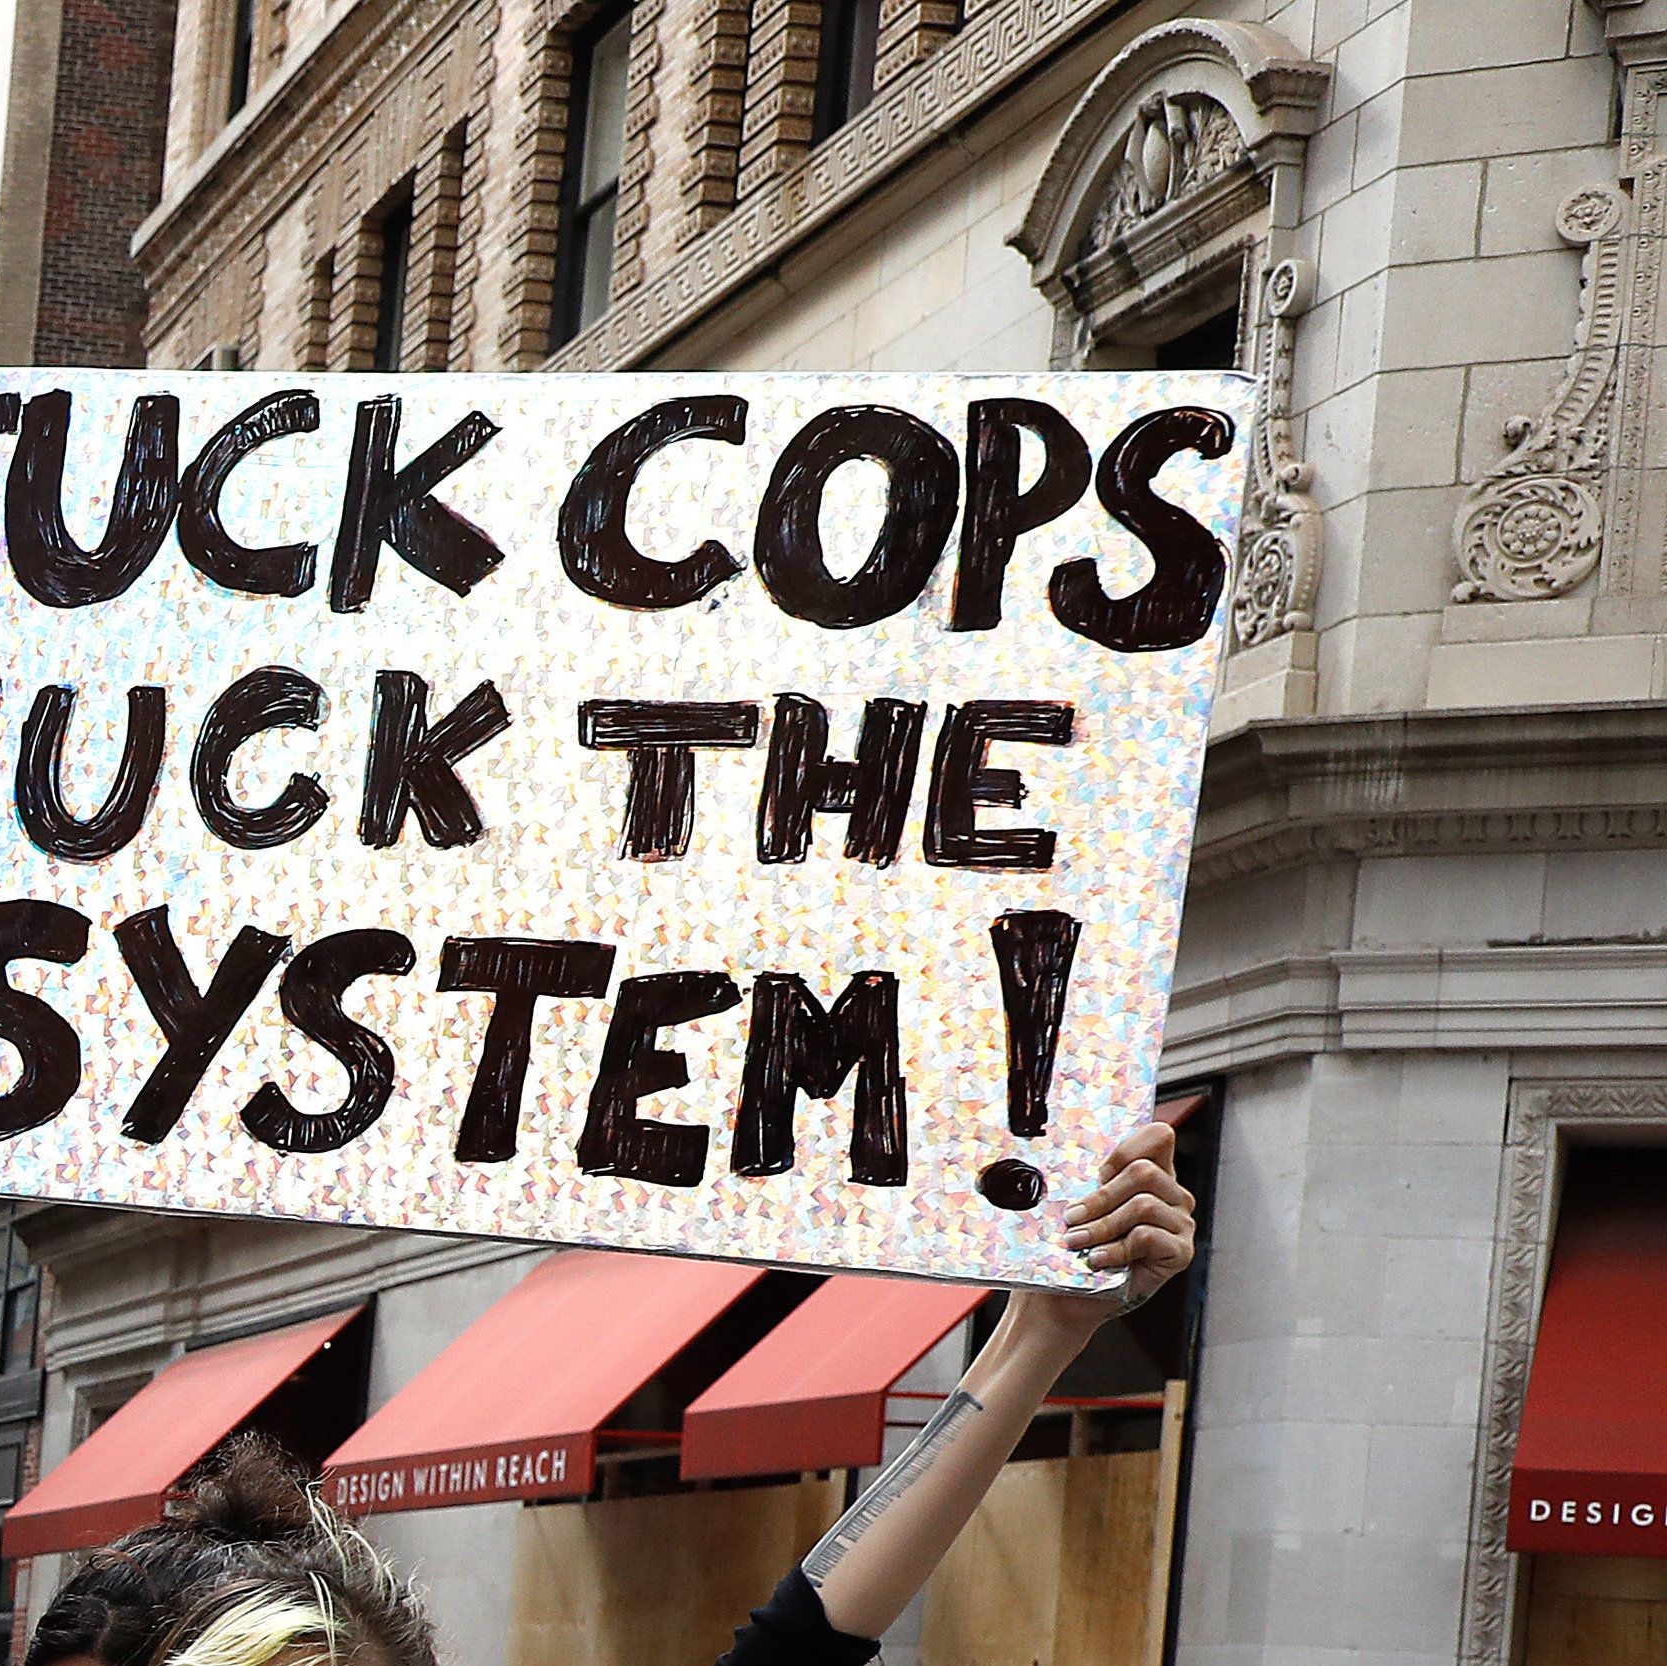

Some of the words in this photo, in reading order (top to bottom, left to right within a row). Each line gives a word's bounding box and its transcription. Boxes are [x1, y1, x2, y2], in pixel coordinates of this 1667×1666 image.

[556, 393, 1238, 653] COPS
[578, 692, 1075, 870] THE
[336, 1470, 407, 1506] DESIGN
[413, 1458, 489, 1496] WITHIN
[495, 1449, 567, 1488] REACH
[1529, 1499, 1667, 1527] DESIG
